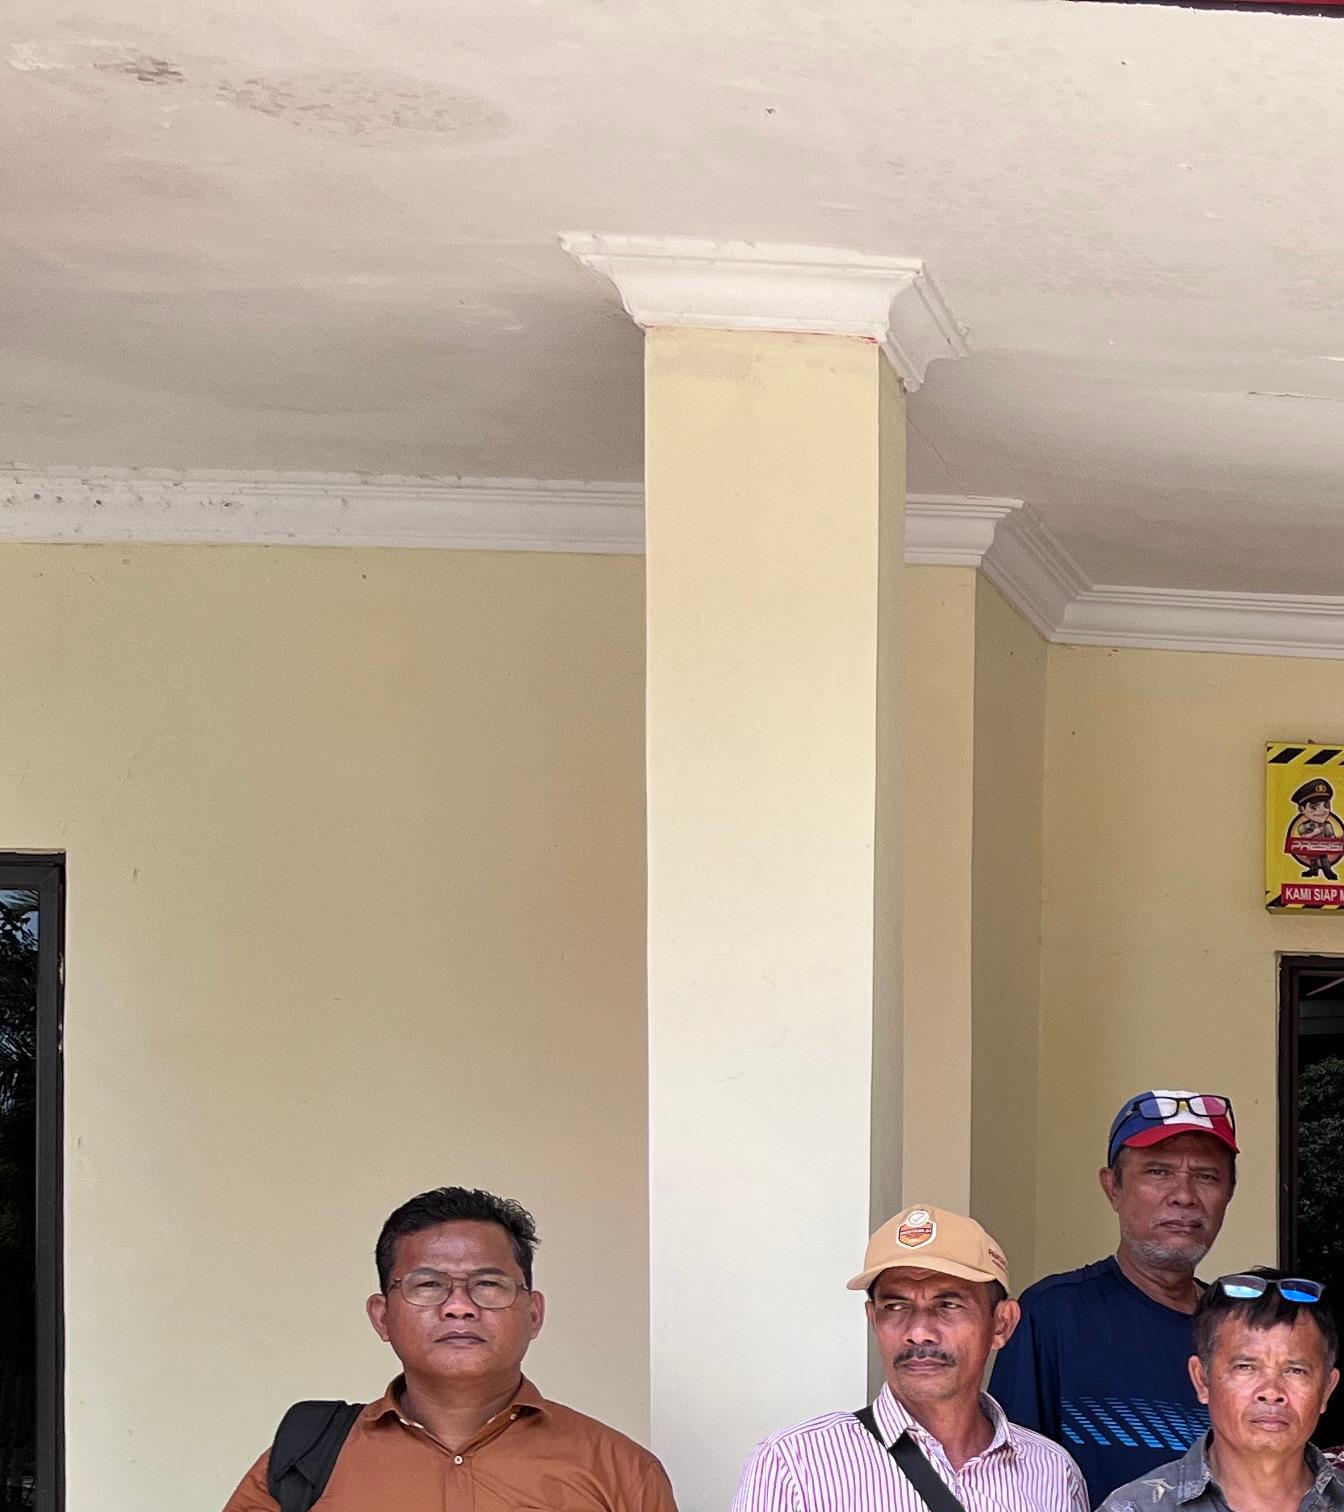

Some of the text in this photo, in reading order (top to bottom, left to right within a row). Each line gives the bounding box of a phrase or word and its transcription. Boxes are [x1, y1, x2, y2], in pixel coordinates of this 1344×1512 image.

[1291, 840, 1343, 851] PRESISI
[1285, 887, 1311, 900] KAMI
[1314, 888, 1337, 901] SIAP
